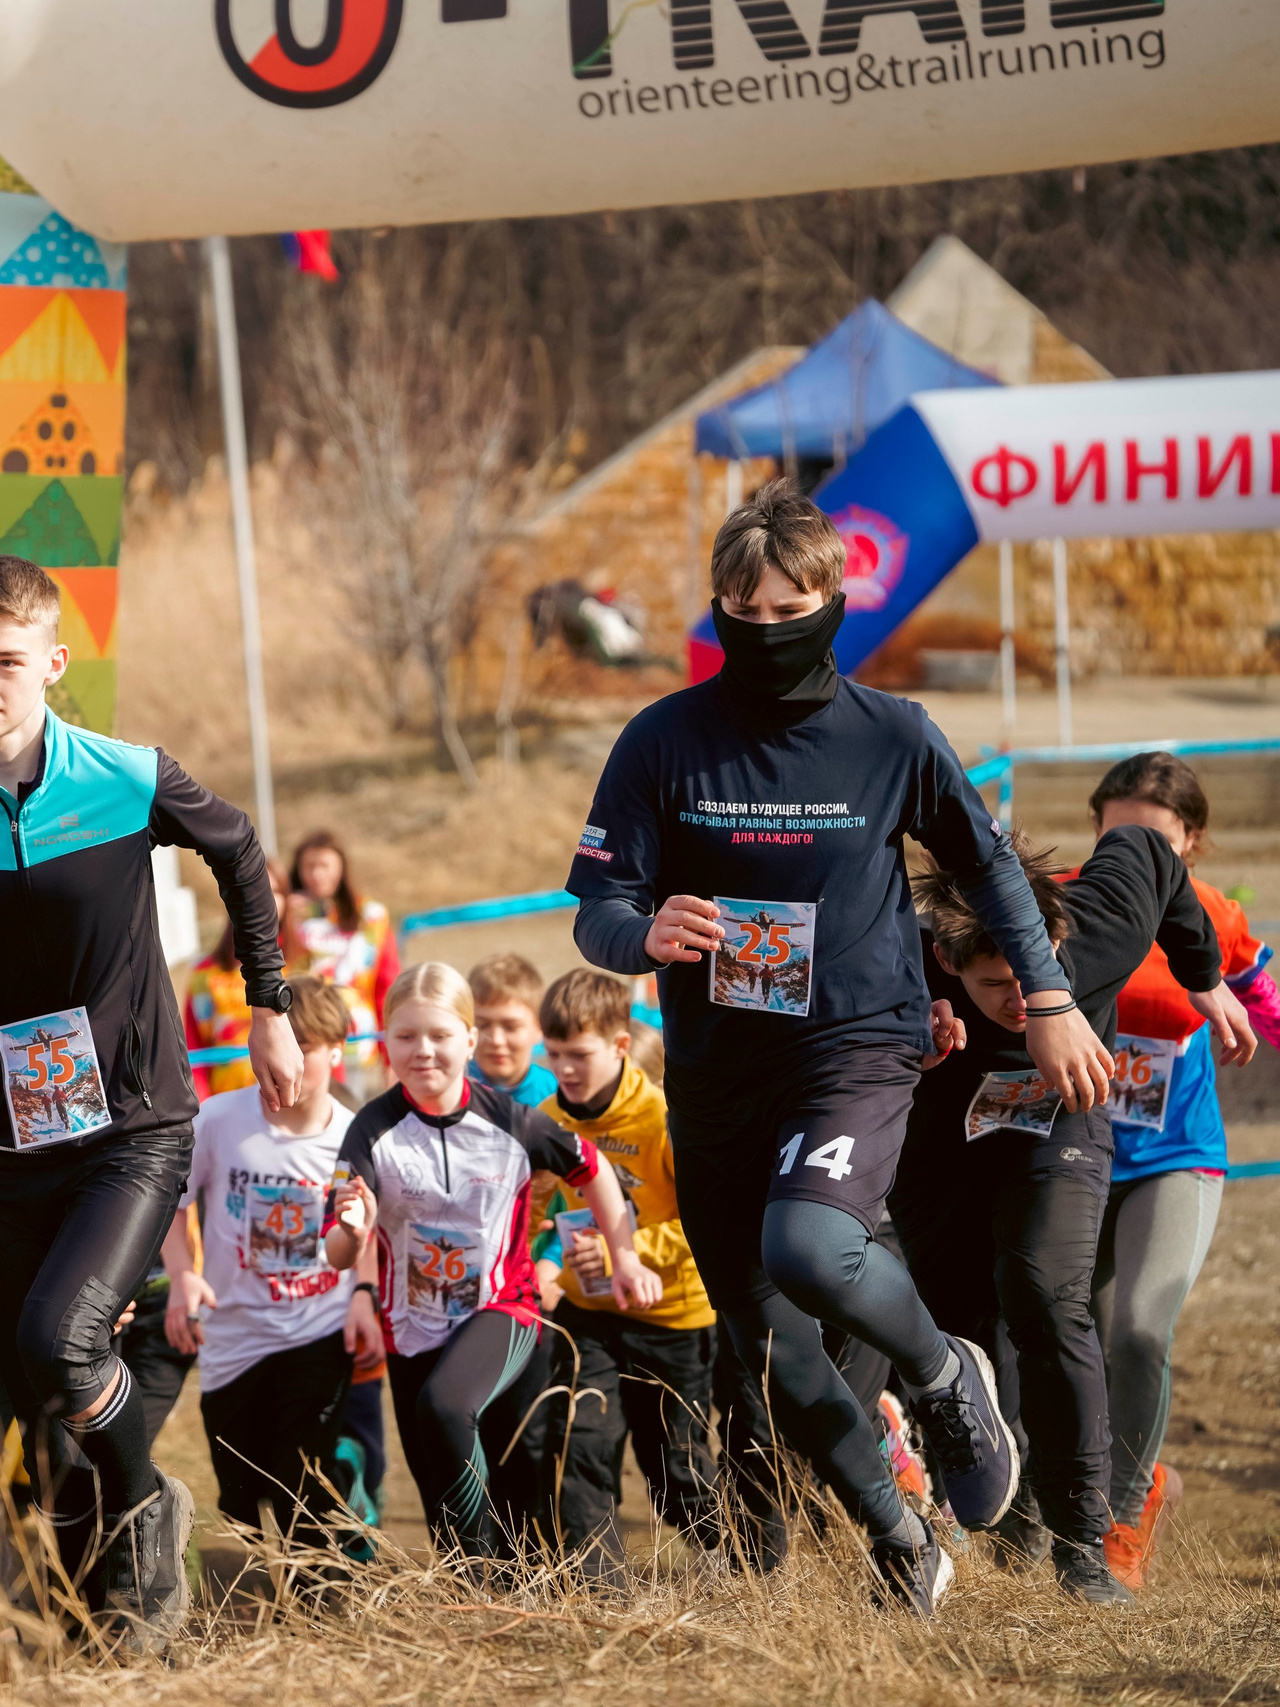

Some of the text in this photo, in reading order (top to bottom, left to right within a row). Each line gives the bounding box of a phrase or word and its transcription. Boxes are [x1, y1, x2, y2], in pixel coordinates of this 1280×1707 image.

[577, 28, 1167, 119] orienteering&trailrunning
[679, 811, 866, 830] ОТКРЫВАЯ РАВНЫЕ ВОЗМОЖНОСТИ
[697, 800, 850, 816] СОЗДАЕМ БУДУЩЕЕ РОССИИ,
[34, 828, 110, 847] NORDSKI
[731, 832, 814, 845] ДЛЯ КАЖДОГО!
[736, 922, 791, 965] 25
[26, 1037, 75, 1090] 55
[1115, 1052, 1153, 1085] 46
[995, 1081, 1048, 1104] 33
[779, 1132, 856, 1181] 14
[265, 1203, 305, 1235] 43
[421, 1243, 466, 1281] 26
